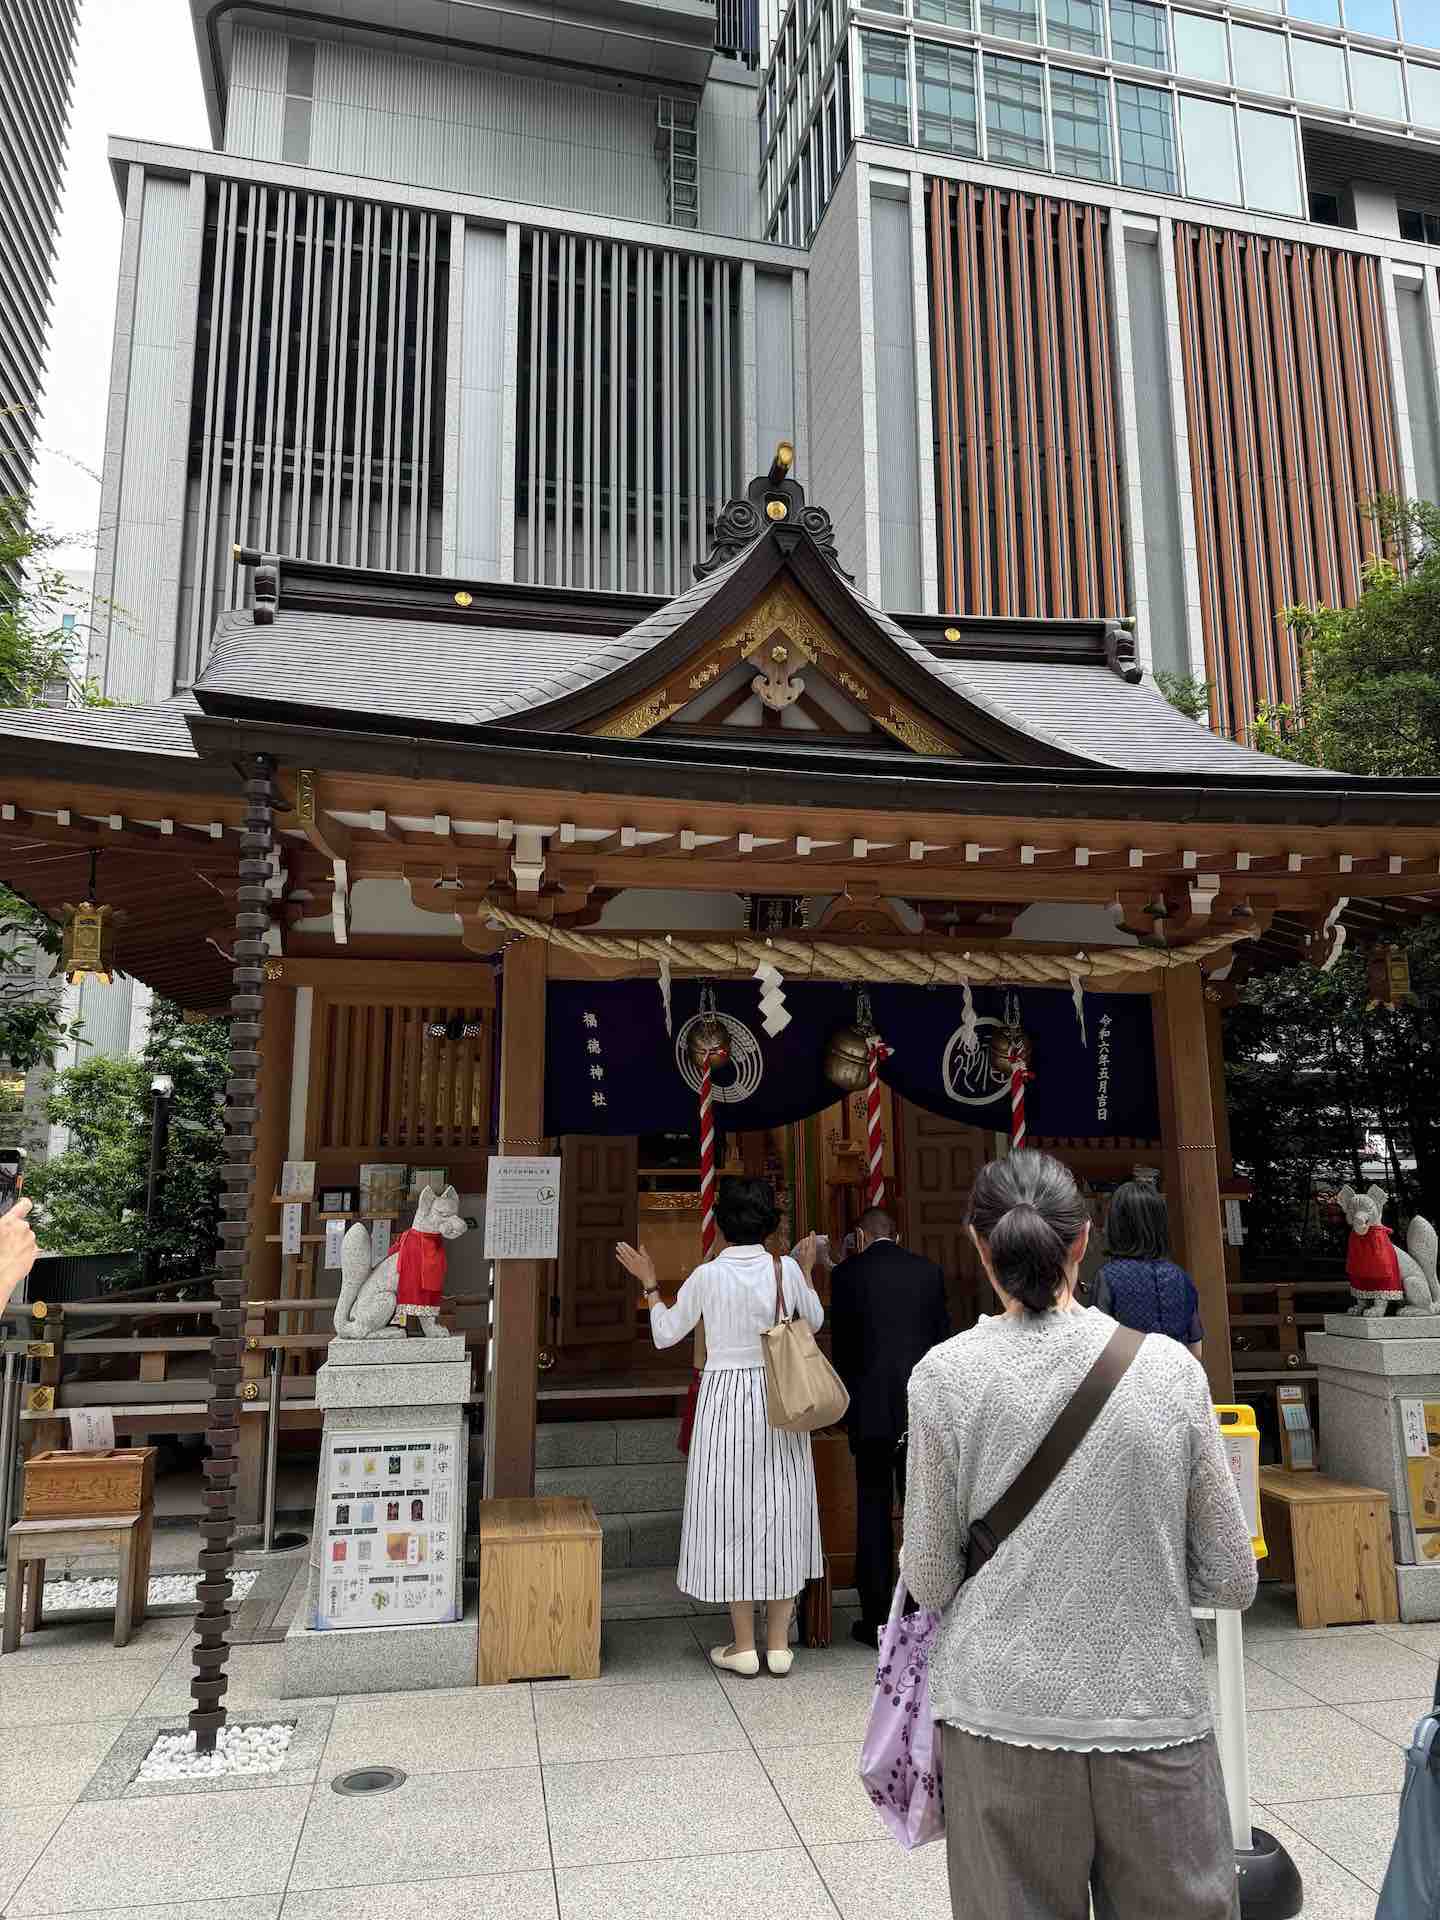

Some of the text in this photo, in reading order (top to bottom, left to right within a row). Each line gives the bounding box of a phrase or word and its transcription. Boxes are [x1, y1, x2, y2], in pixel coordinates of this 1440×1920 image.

[582, 1011, 608, 1107] 福徳神社
[1096, 1013, 1113, 1121] 令和六年五月吉日
